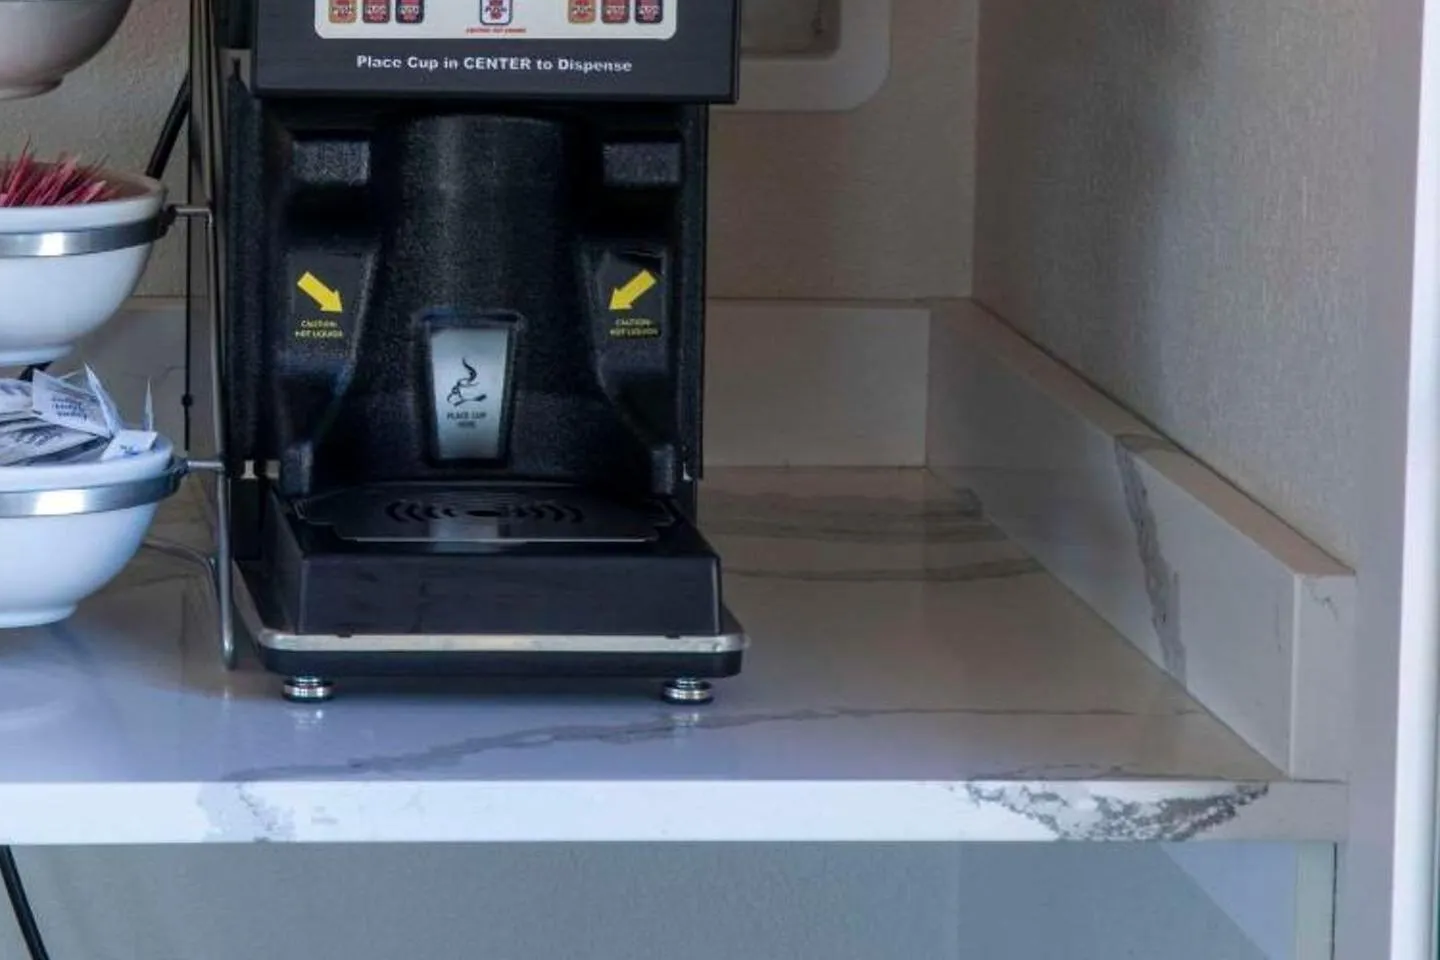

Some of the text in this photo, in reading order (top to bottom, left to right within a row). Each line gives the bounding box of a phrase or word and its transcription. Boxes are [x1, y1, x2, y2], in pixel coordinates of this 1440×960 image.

[356, 55, 633, 73] Place Cup in CENTER to Dispense
